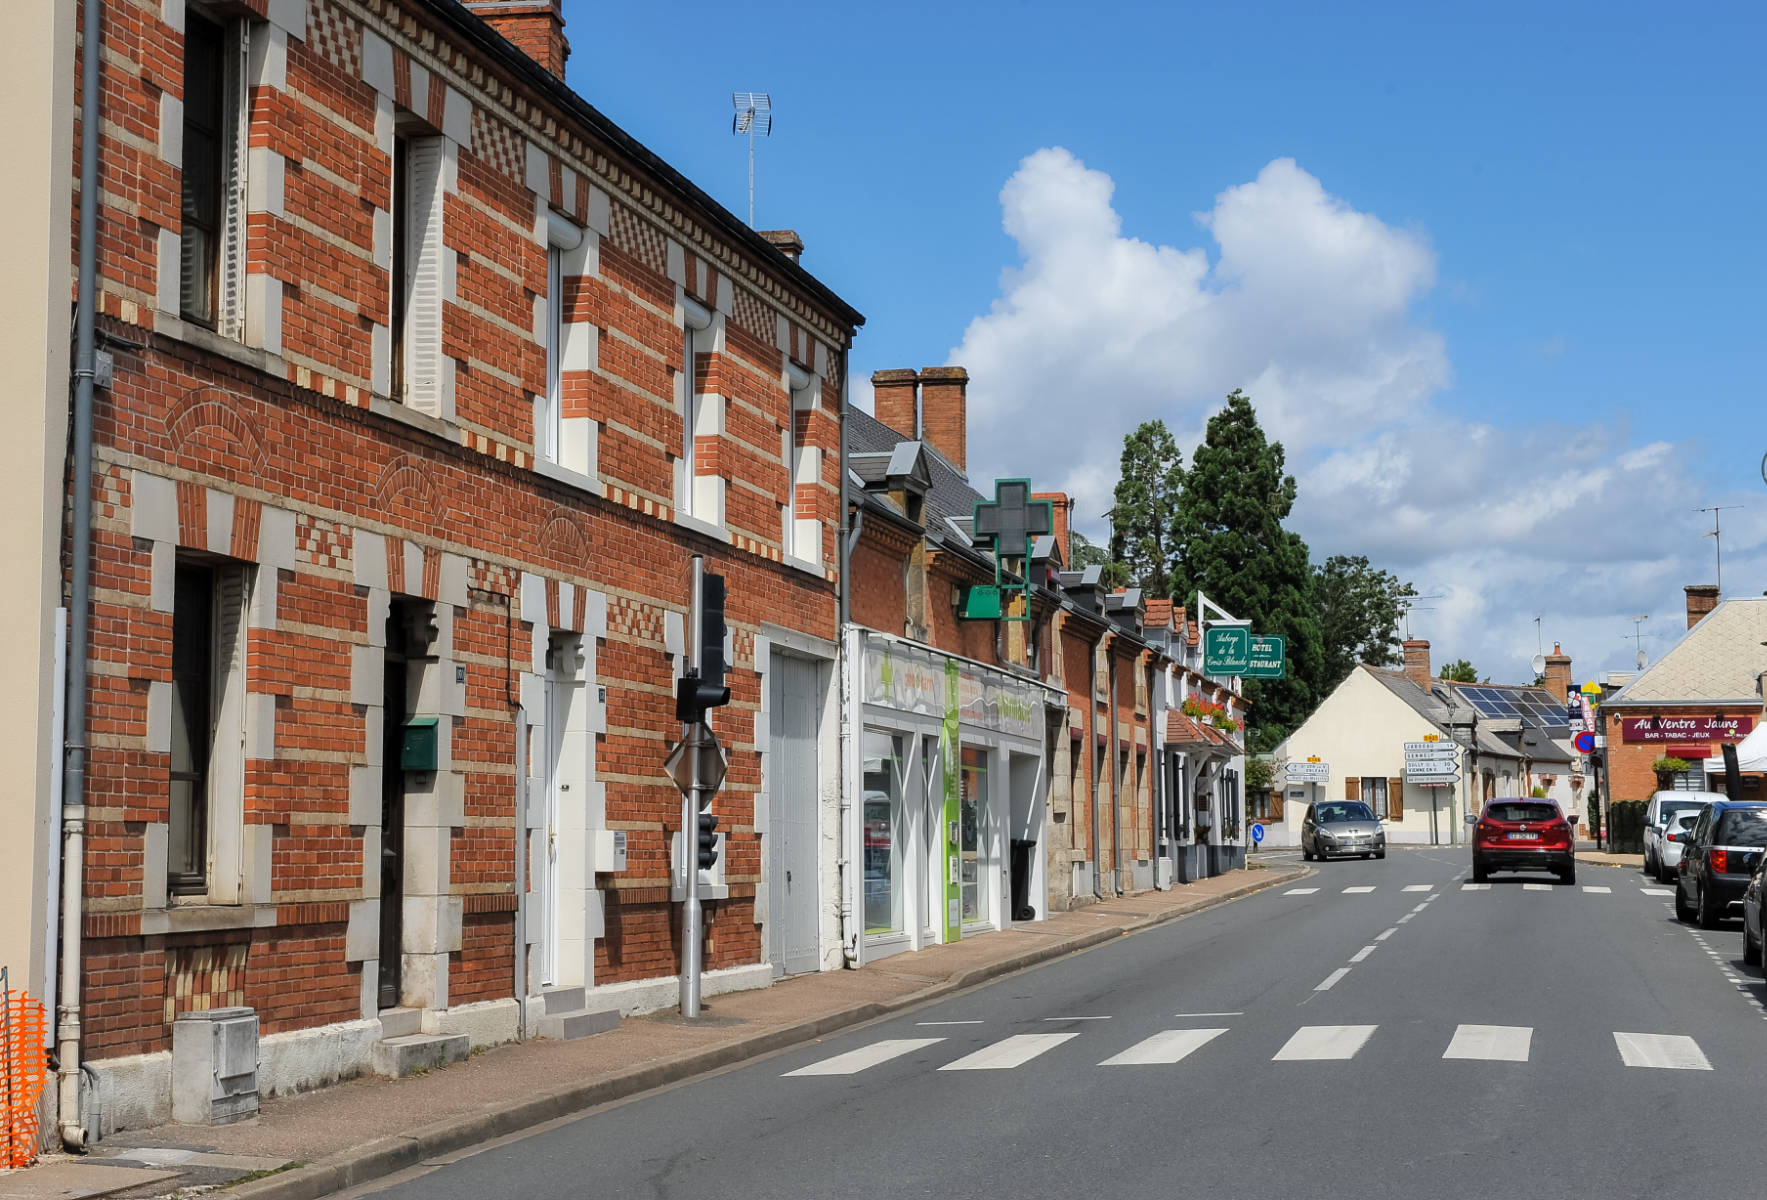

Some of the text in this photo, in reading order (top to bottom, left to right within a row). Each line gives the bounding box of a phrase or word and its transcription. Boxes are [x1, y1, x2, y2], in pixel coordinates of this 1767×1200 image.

[1216, 632, 1239, 647] Auberge
[1218, 645, 1235, 655] de la
[1207, 655, 1247, 666] Croix Blanche
[1634, 717, 1739, 730] Au Ventre Jaune
